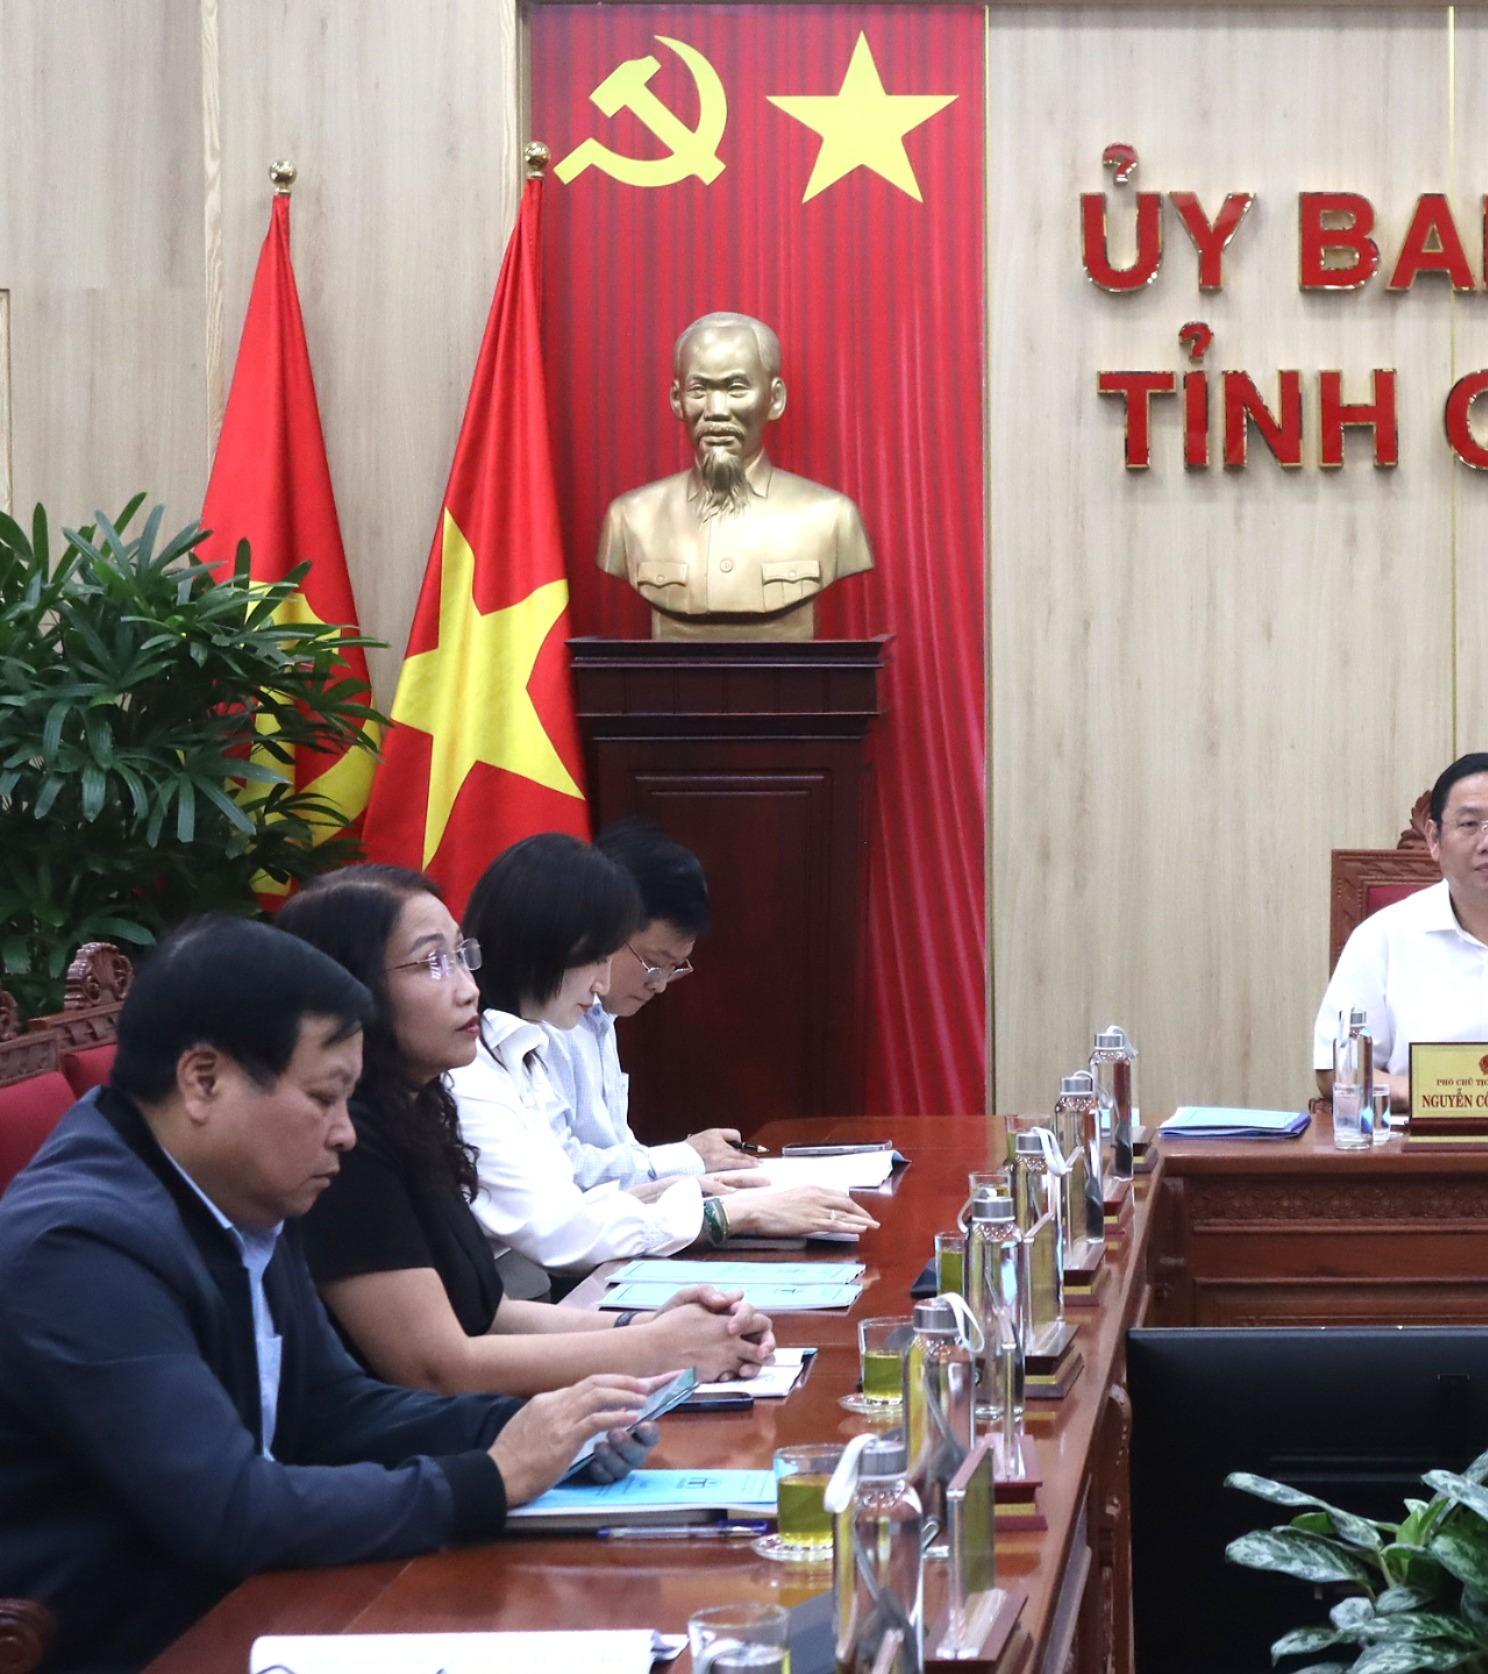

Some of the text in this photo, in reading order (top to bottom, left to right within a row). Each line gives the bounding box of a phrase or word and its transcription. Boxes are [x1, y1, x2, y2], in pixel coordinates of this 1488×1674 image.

[1080, 143, 1256, 292] ỦY
[1096, 322, 1399, 470] TỈNH
[1422, 1088, 1473, 1108] NGUYỄN
